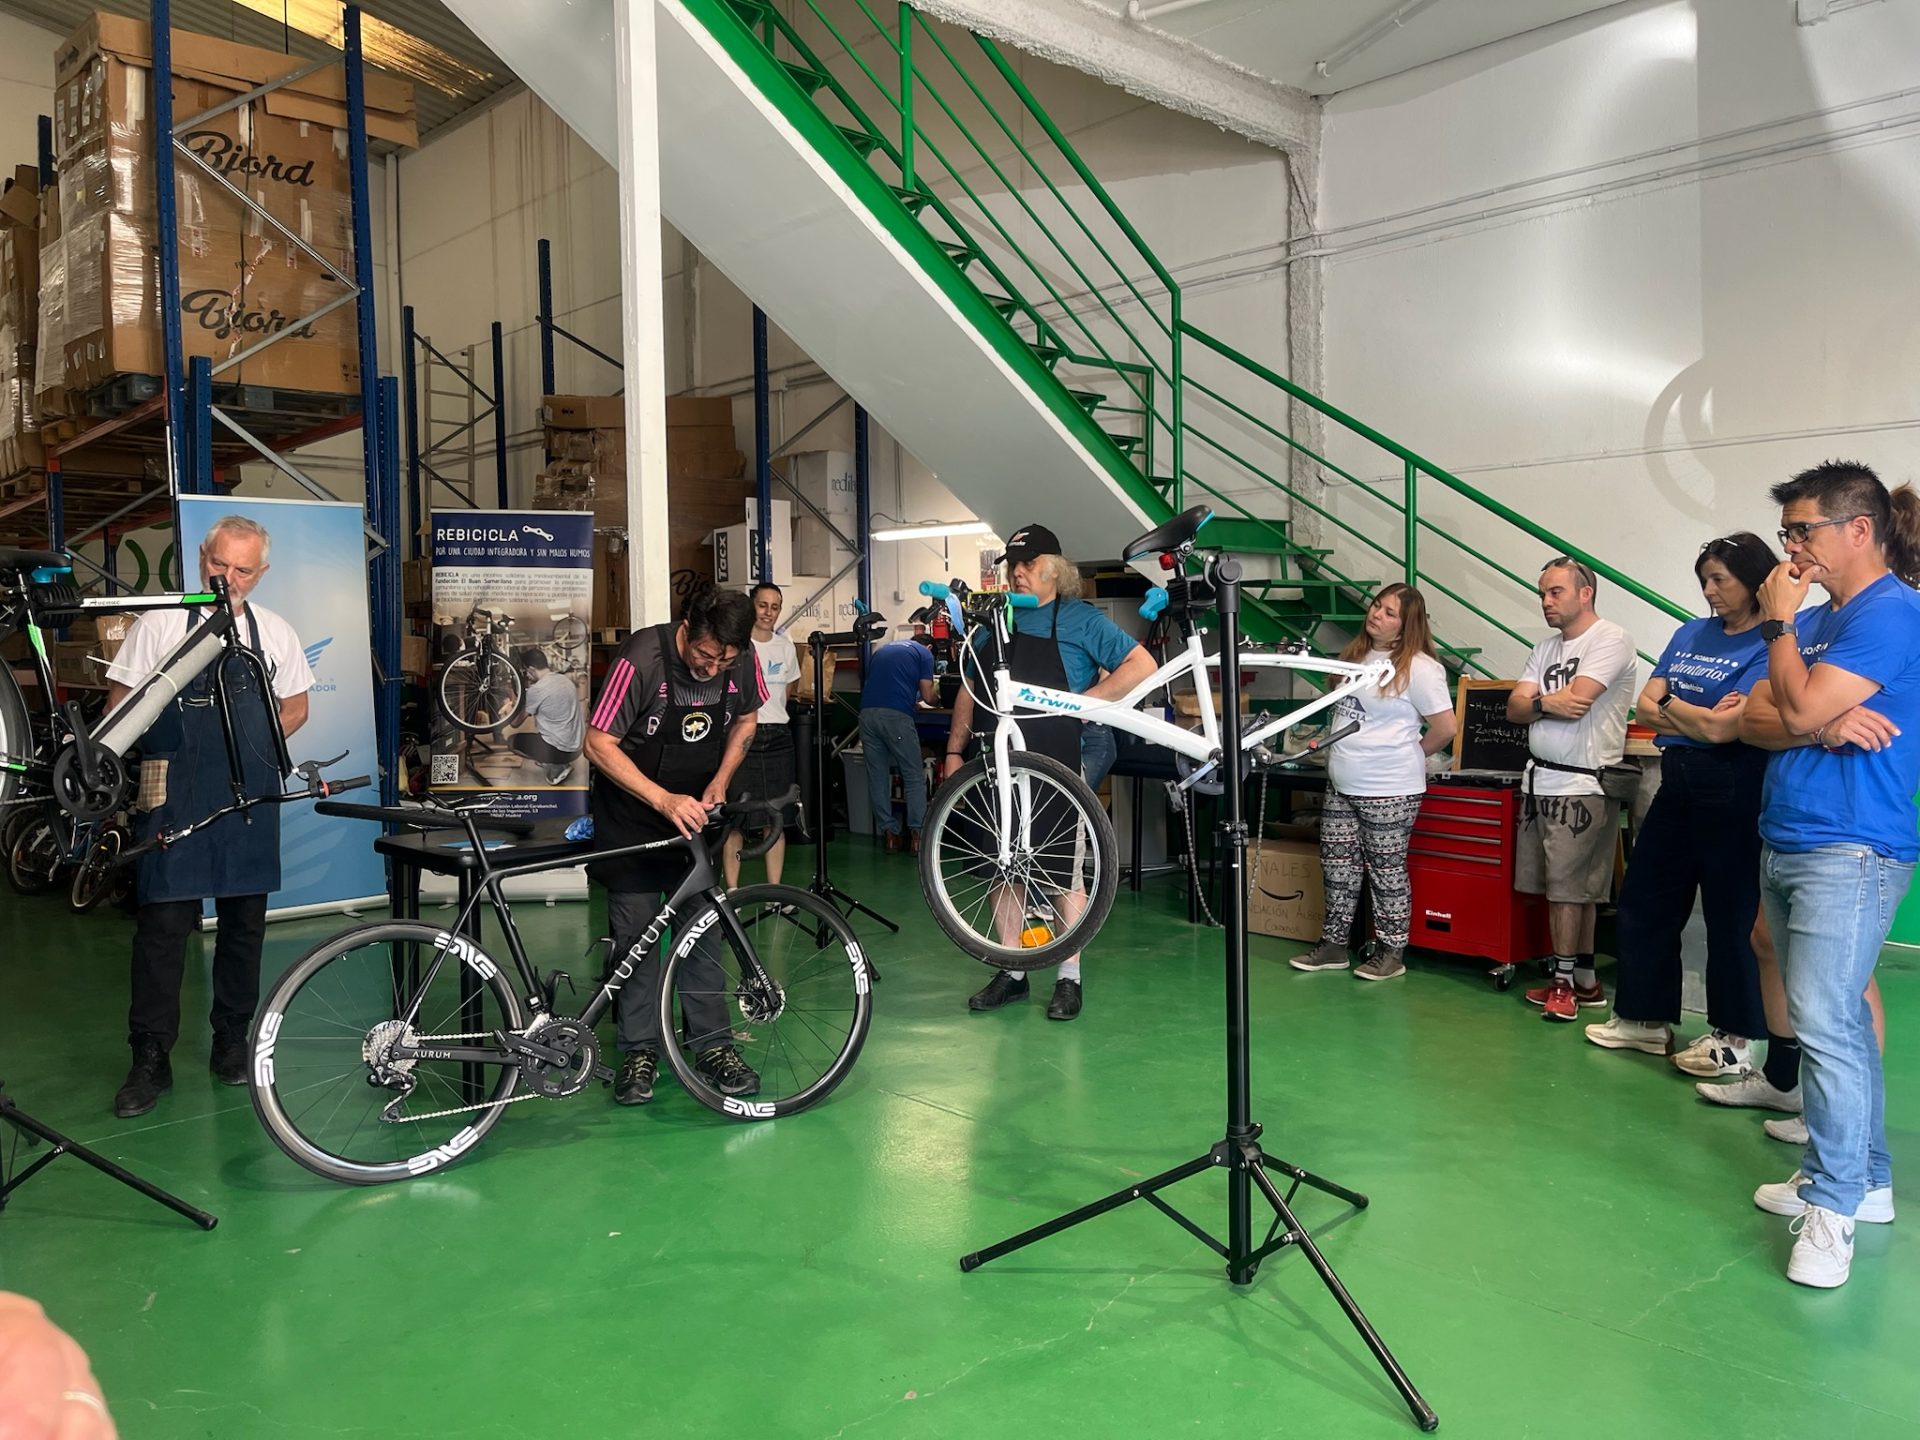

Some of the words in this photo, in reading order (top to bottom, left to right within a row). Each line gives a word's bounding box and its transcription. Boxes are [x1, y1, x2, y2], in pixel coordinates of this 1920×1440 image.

[181, 131, 314, 186] Bjord
[436, 528, 519, 541] REBICICLA
[435, 546, 447, 556] POR
[448, 546, 461, 556] UNA
[463, 547, 485, 556] CIUDAD
[487, 547, 527, 557] INTEGRADORA
[530, 548, 534, 557] Y
[536, 548, 547, 557] SIN
[549, 548, 567, 558] MALOS
[569, 548, 591, 558] HUMOS
[718, 536, 728, 580] Tacx
[604, 904, 677, 1001] AURUM
[755, 964, 773, 992] AURUM
[412, 1050, 451, 1059] AURUM
